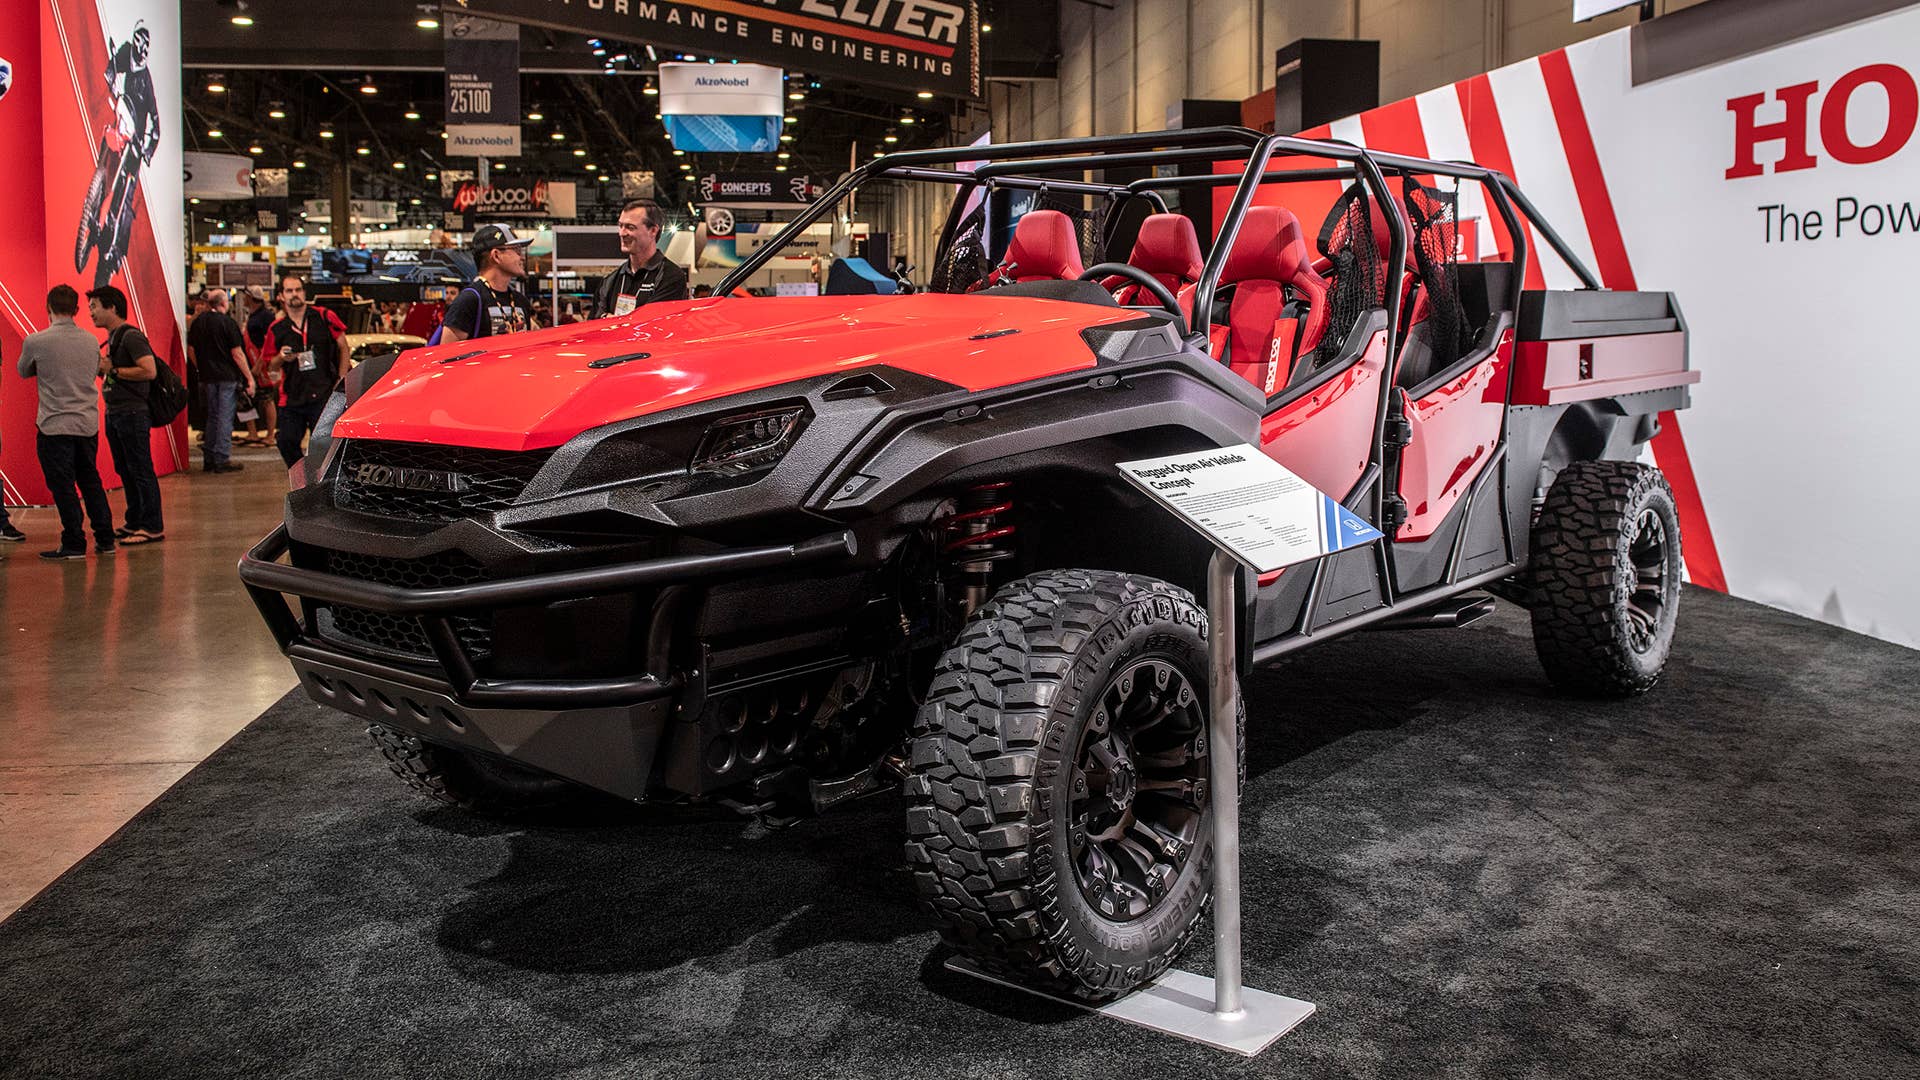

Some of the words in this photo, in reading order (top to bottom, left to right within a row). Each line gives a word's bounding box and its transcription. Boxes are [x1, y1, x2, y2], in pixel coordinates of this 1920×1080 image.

[564, 0, 750, 37] ORMANCE
[771, 28, 953, 76] ENGINEERING
[450, 82, 493, 90] PERFORMANCE
[695, 76, 749, 87] AkzoNobel
[450, 89, 491, 114] 25100
[1725, 63, 1920, 180] HO
[454, 136, 514, 146] AkzoNobel
[721, 182, 772, 193] CONCEPTS
[1758, 204, 1823, 243] The
[1836, 197, 1920, 238] Pow
[1132, 463, 1176, 479] Rugged
[1171, 461, 1203, 474] Open
[1197, 458, 1215, 469] Air
[1209, 453, 1247, 466] Vehicle
[1149, 477, 1195, 490] Concept
